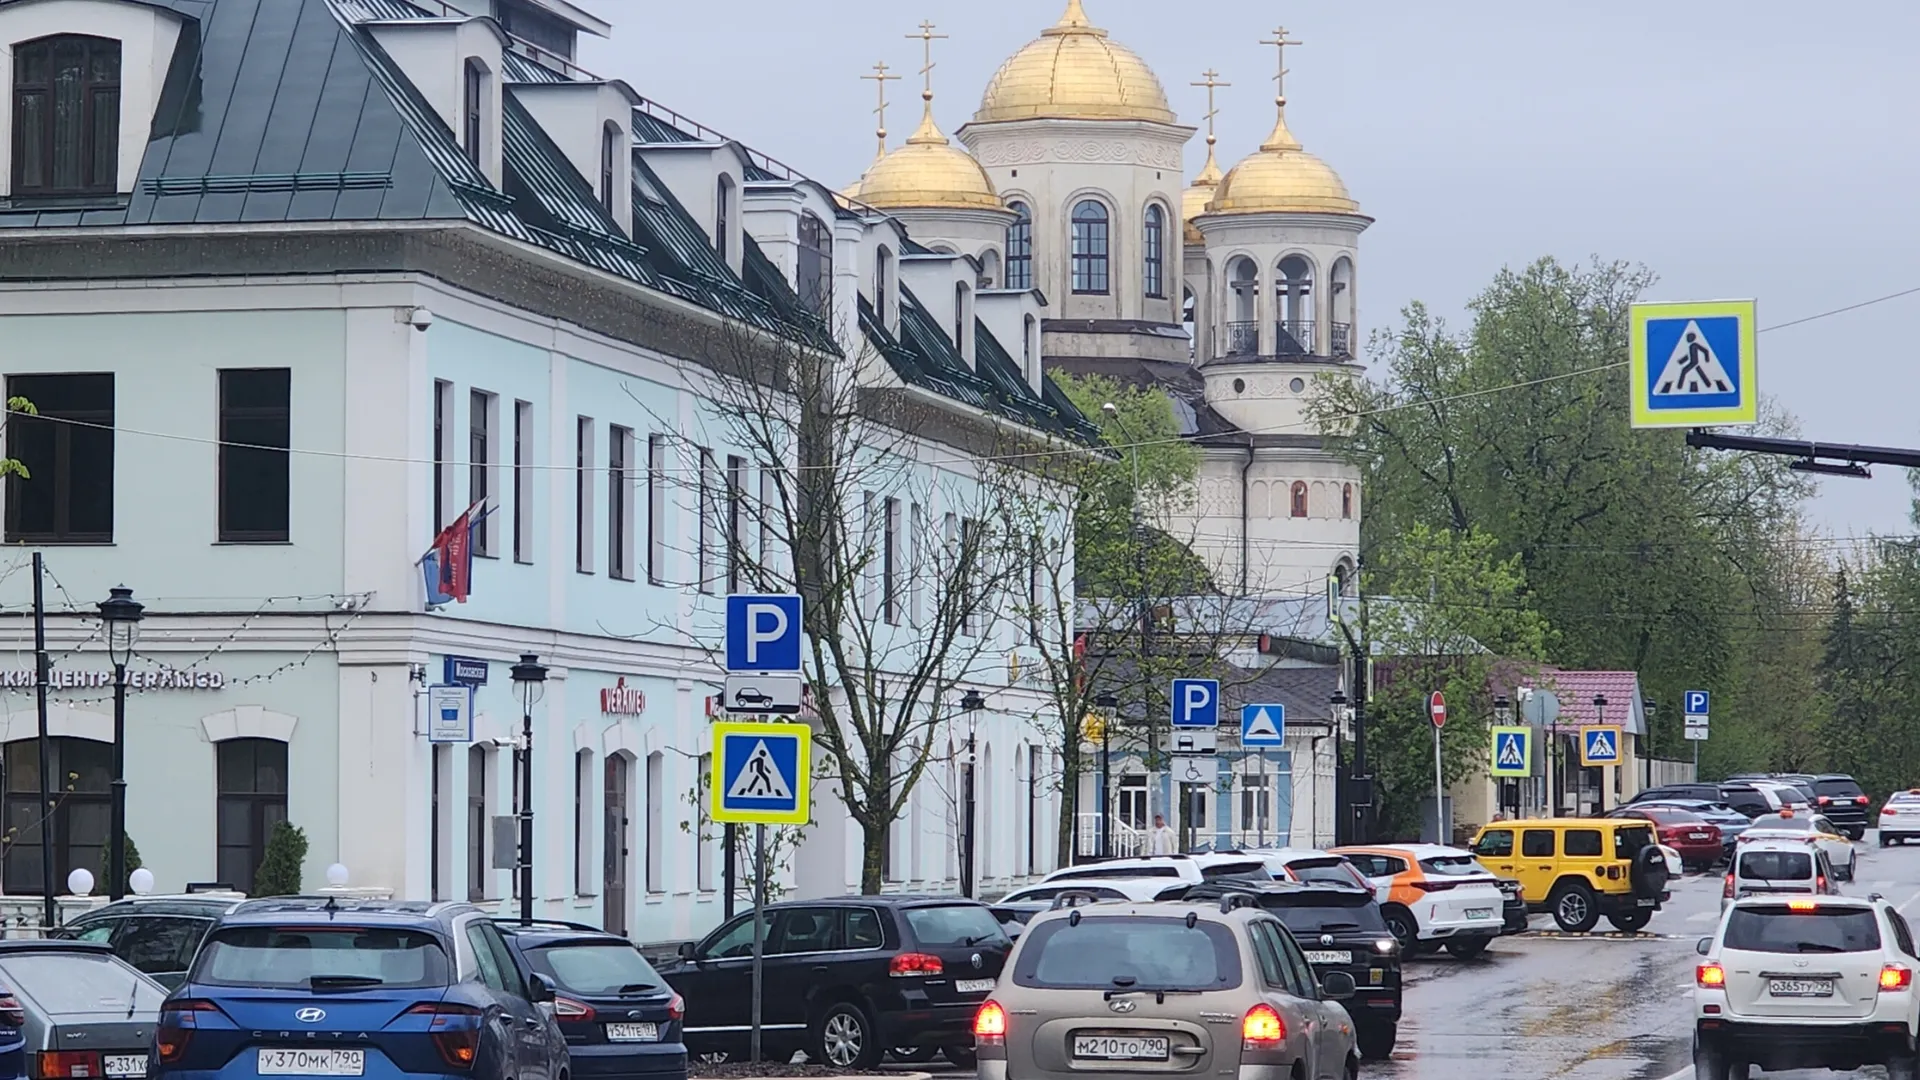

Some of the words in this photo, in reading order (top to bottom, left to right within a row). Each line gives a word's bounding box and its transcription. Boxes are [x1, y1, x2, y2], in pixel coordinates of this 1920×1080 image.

[747, 603, 788, 663] P
[0, 671, 38, 687] КИ
[50, 670, 110, 690] ЦЕНТР
[1185, 684, 1210, 721] P
[1691, 693, 1705, 712] P
[265, 1051, 329, 1068] У370МК
